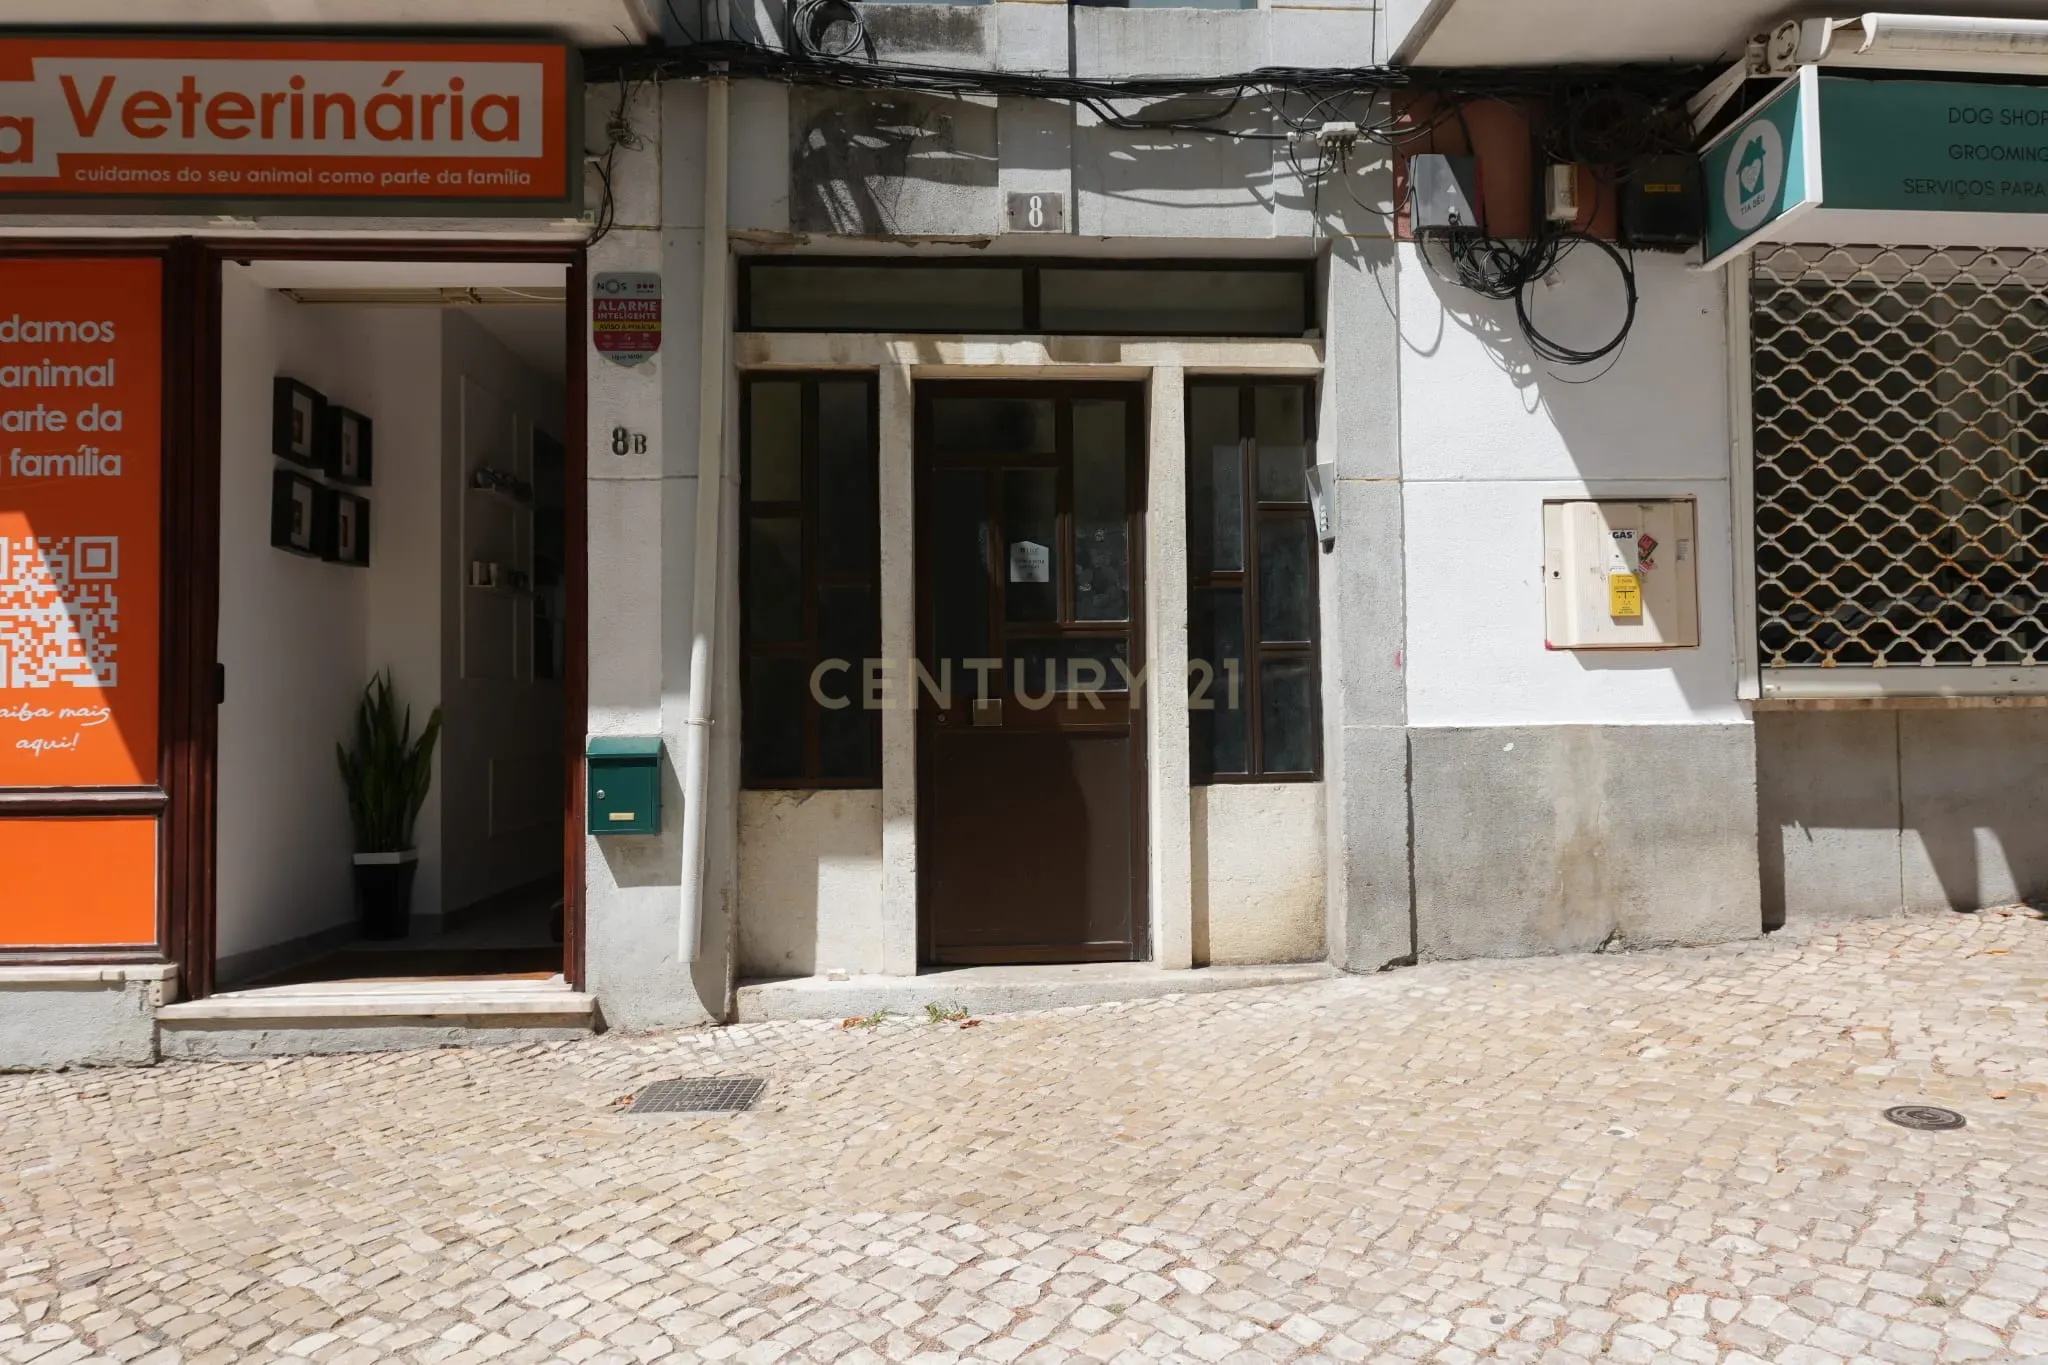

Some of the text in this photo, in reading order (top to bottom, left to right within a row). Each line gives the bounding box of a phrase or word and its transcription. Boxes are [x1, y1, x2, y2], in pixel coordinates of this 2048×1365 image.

[59, 70, 520, 142] Veterinária
[1948, 106, 1994, 125] DOG
[1948, 143, 2048, 162] GROOMING
[75, 166, 531, 188] cuidamos do seu animal como parte da família
[1903, 178, 2046, 200] SERVIÇOS PARA
[1028, 195, 1043, 228] 8
[596, 278, 628, 294] NOS
[597, 312, 657, 320] INTELIGENTE
[598, 301, 657, 312] ALARME
[0, 313, 115, 343] damos
[0, 358, 115, 387] animal
[0, 403, 122, 432] arte da
[9, 444, 122, 477] família
[1612, 531, 1633, 539] GAS
[59, 705, 111, 727] mais
[15, 732, 80, 757] aqui!
